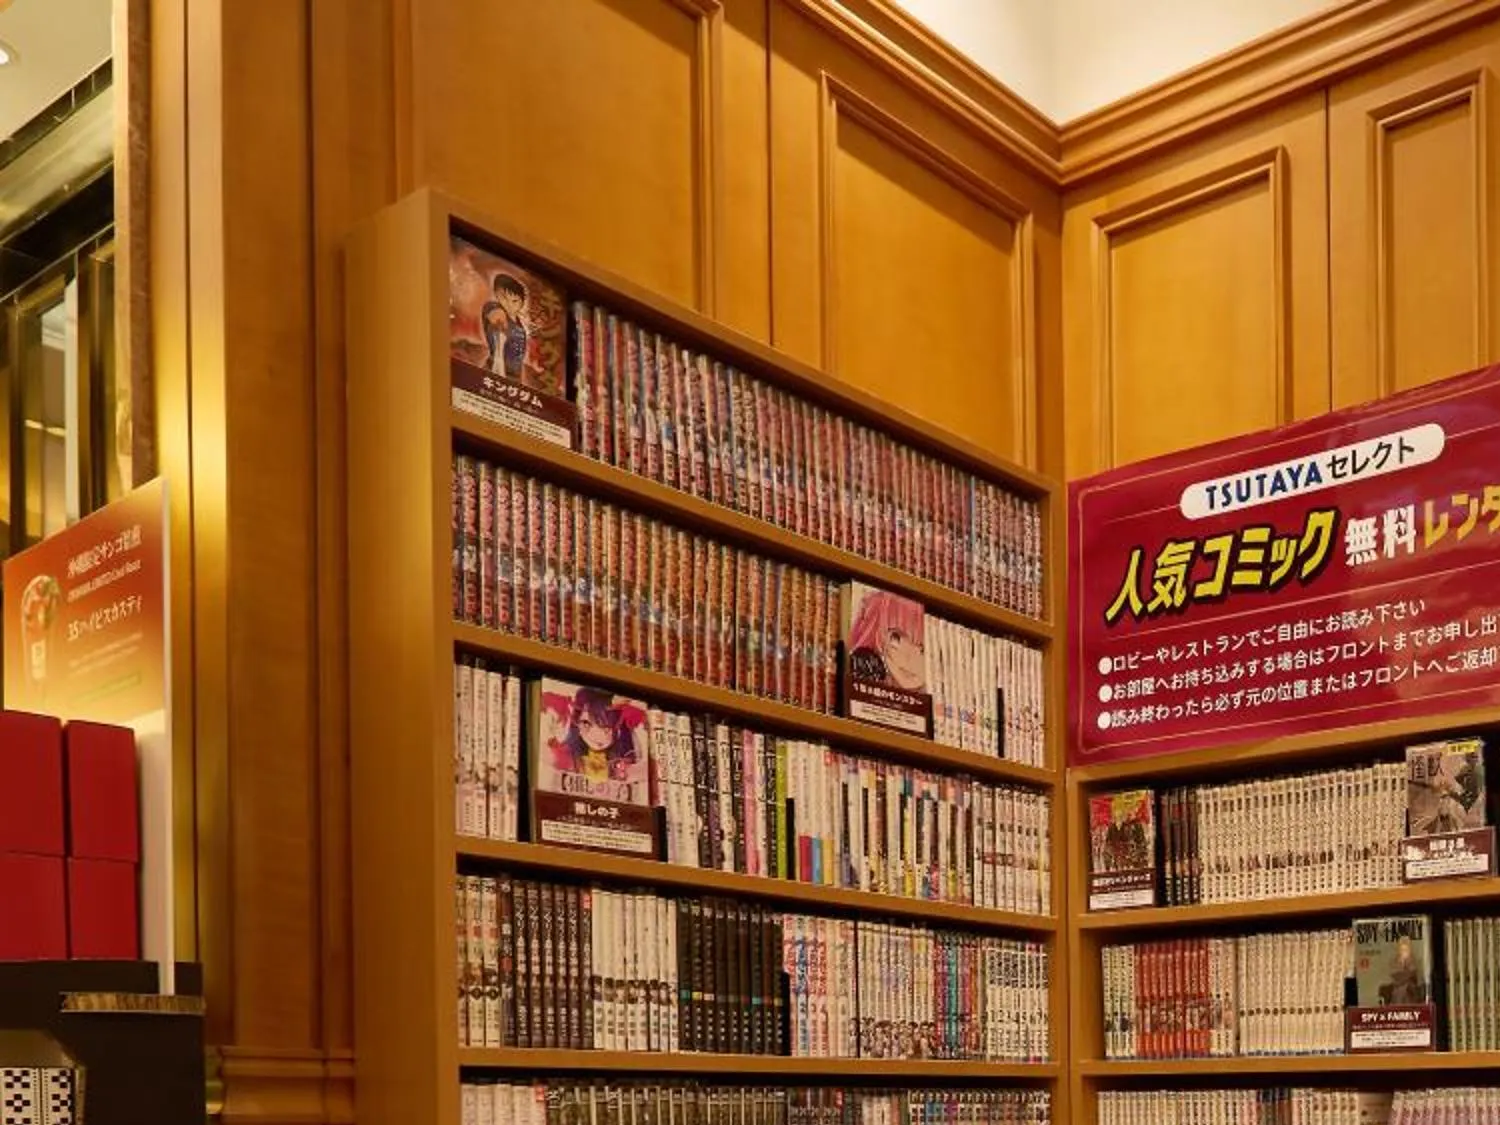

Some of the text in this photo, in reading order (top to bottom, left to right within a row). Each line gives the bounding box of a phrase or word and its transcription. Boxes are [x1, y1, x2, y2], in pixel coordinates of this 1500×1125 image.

[484, 376, 543, 409] キングダム
[1106, 510, 1336, 620] 人気コミック
[1113, 599, 1425, 673] ロビーやレストランでご自由にお読み下さい
